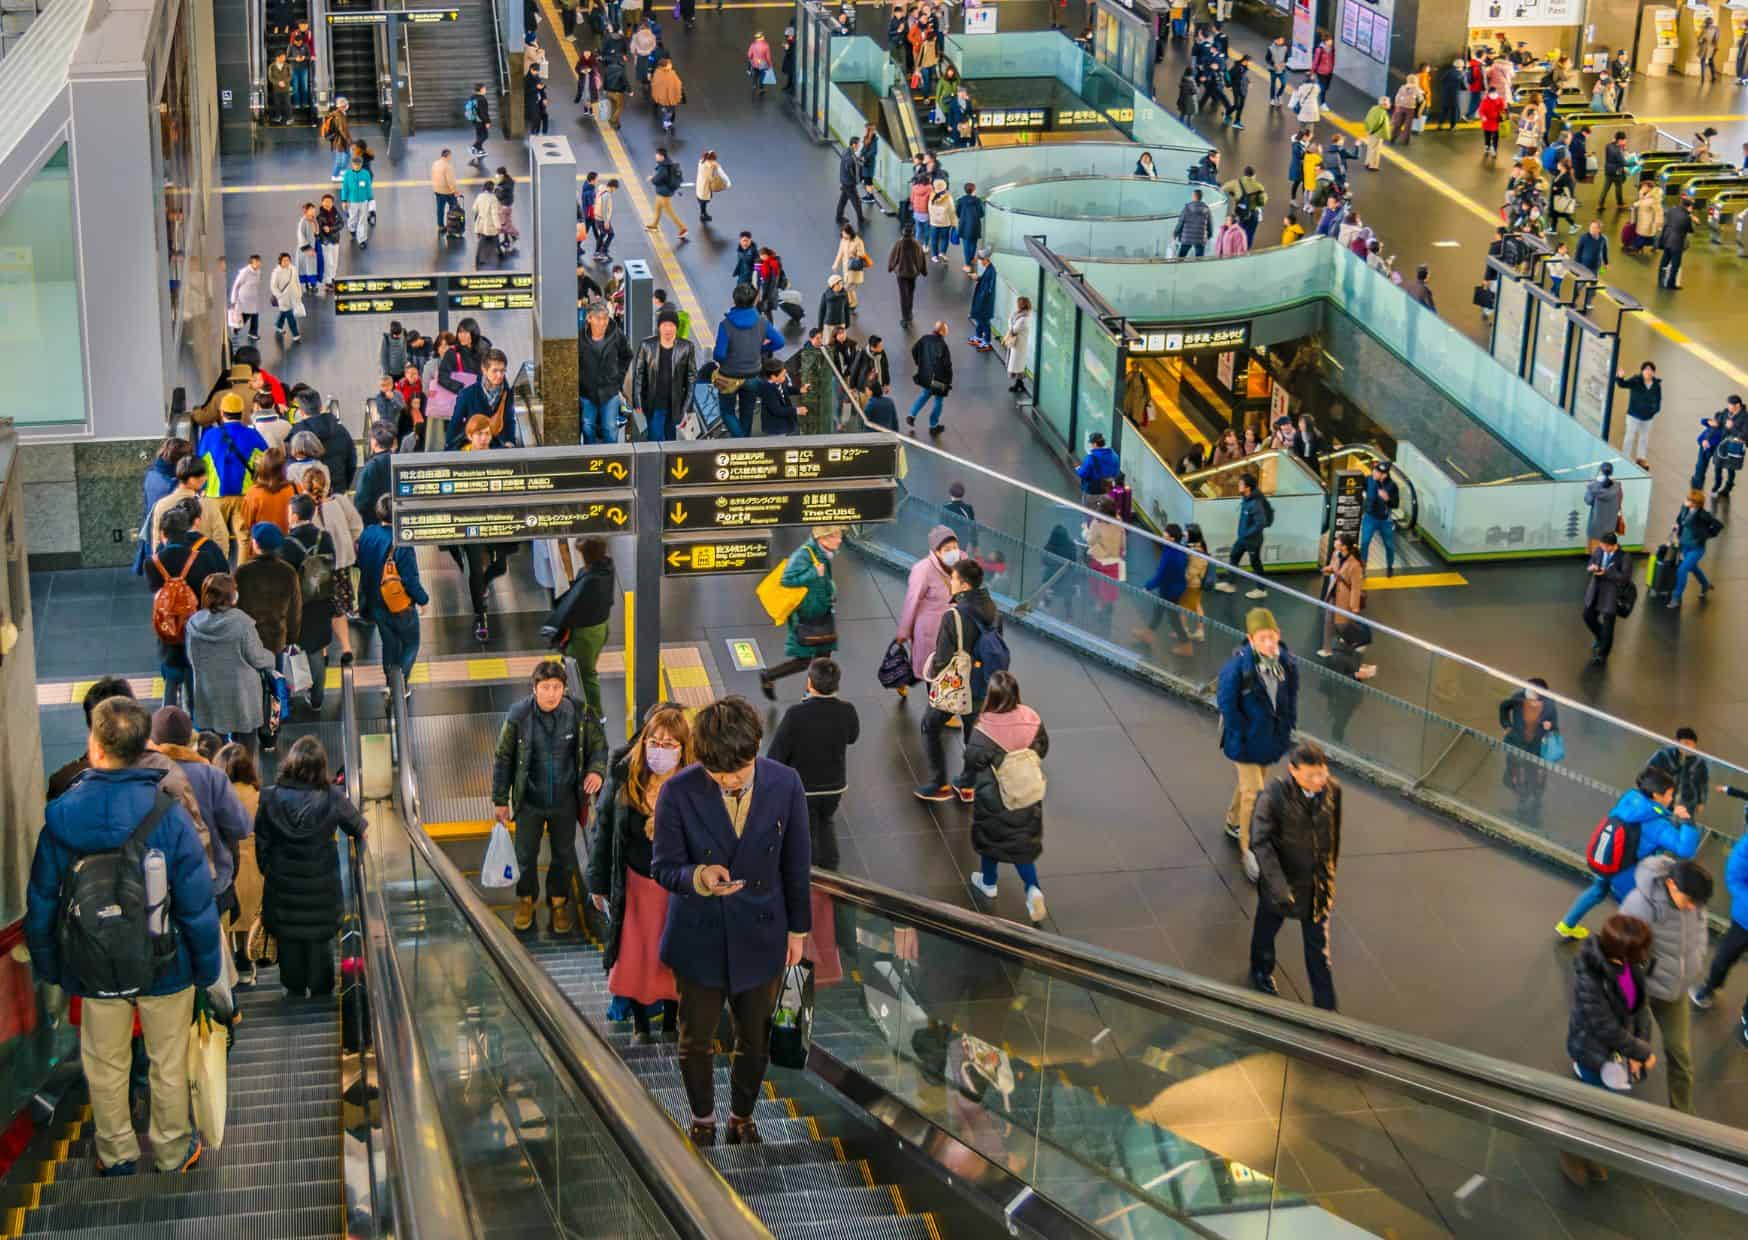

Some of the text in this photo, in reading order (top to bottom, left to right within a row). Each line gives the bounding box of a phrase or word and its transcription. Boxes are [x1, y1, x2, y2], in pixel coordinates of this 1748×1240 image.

[590, 460, 604, 471] 2F
[590, 505, 604, 516] 2F
[825, 508, 857, 516] CUBE
[716, 512, 751, 522] Porta
